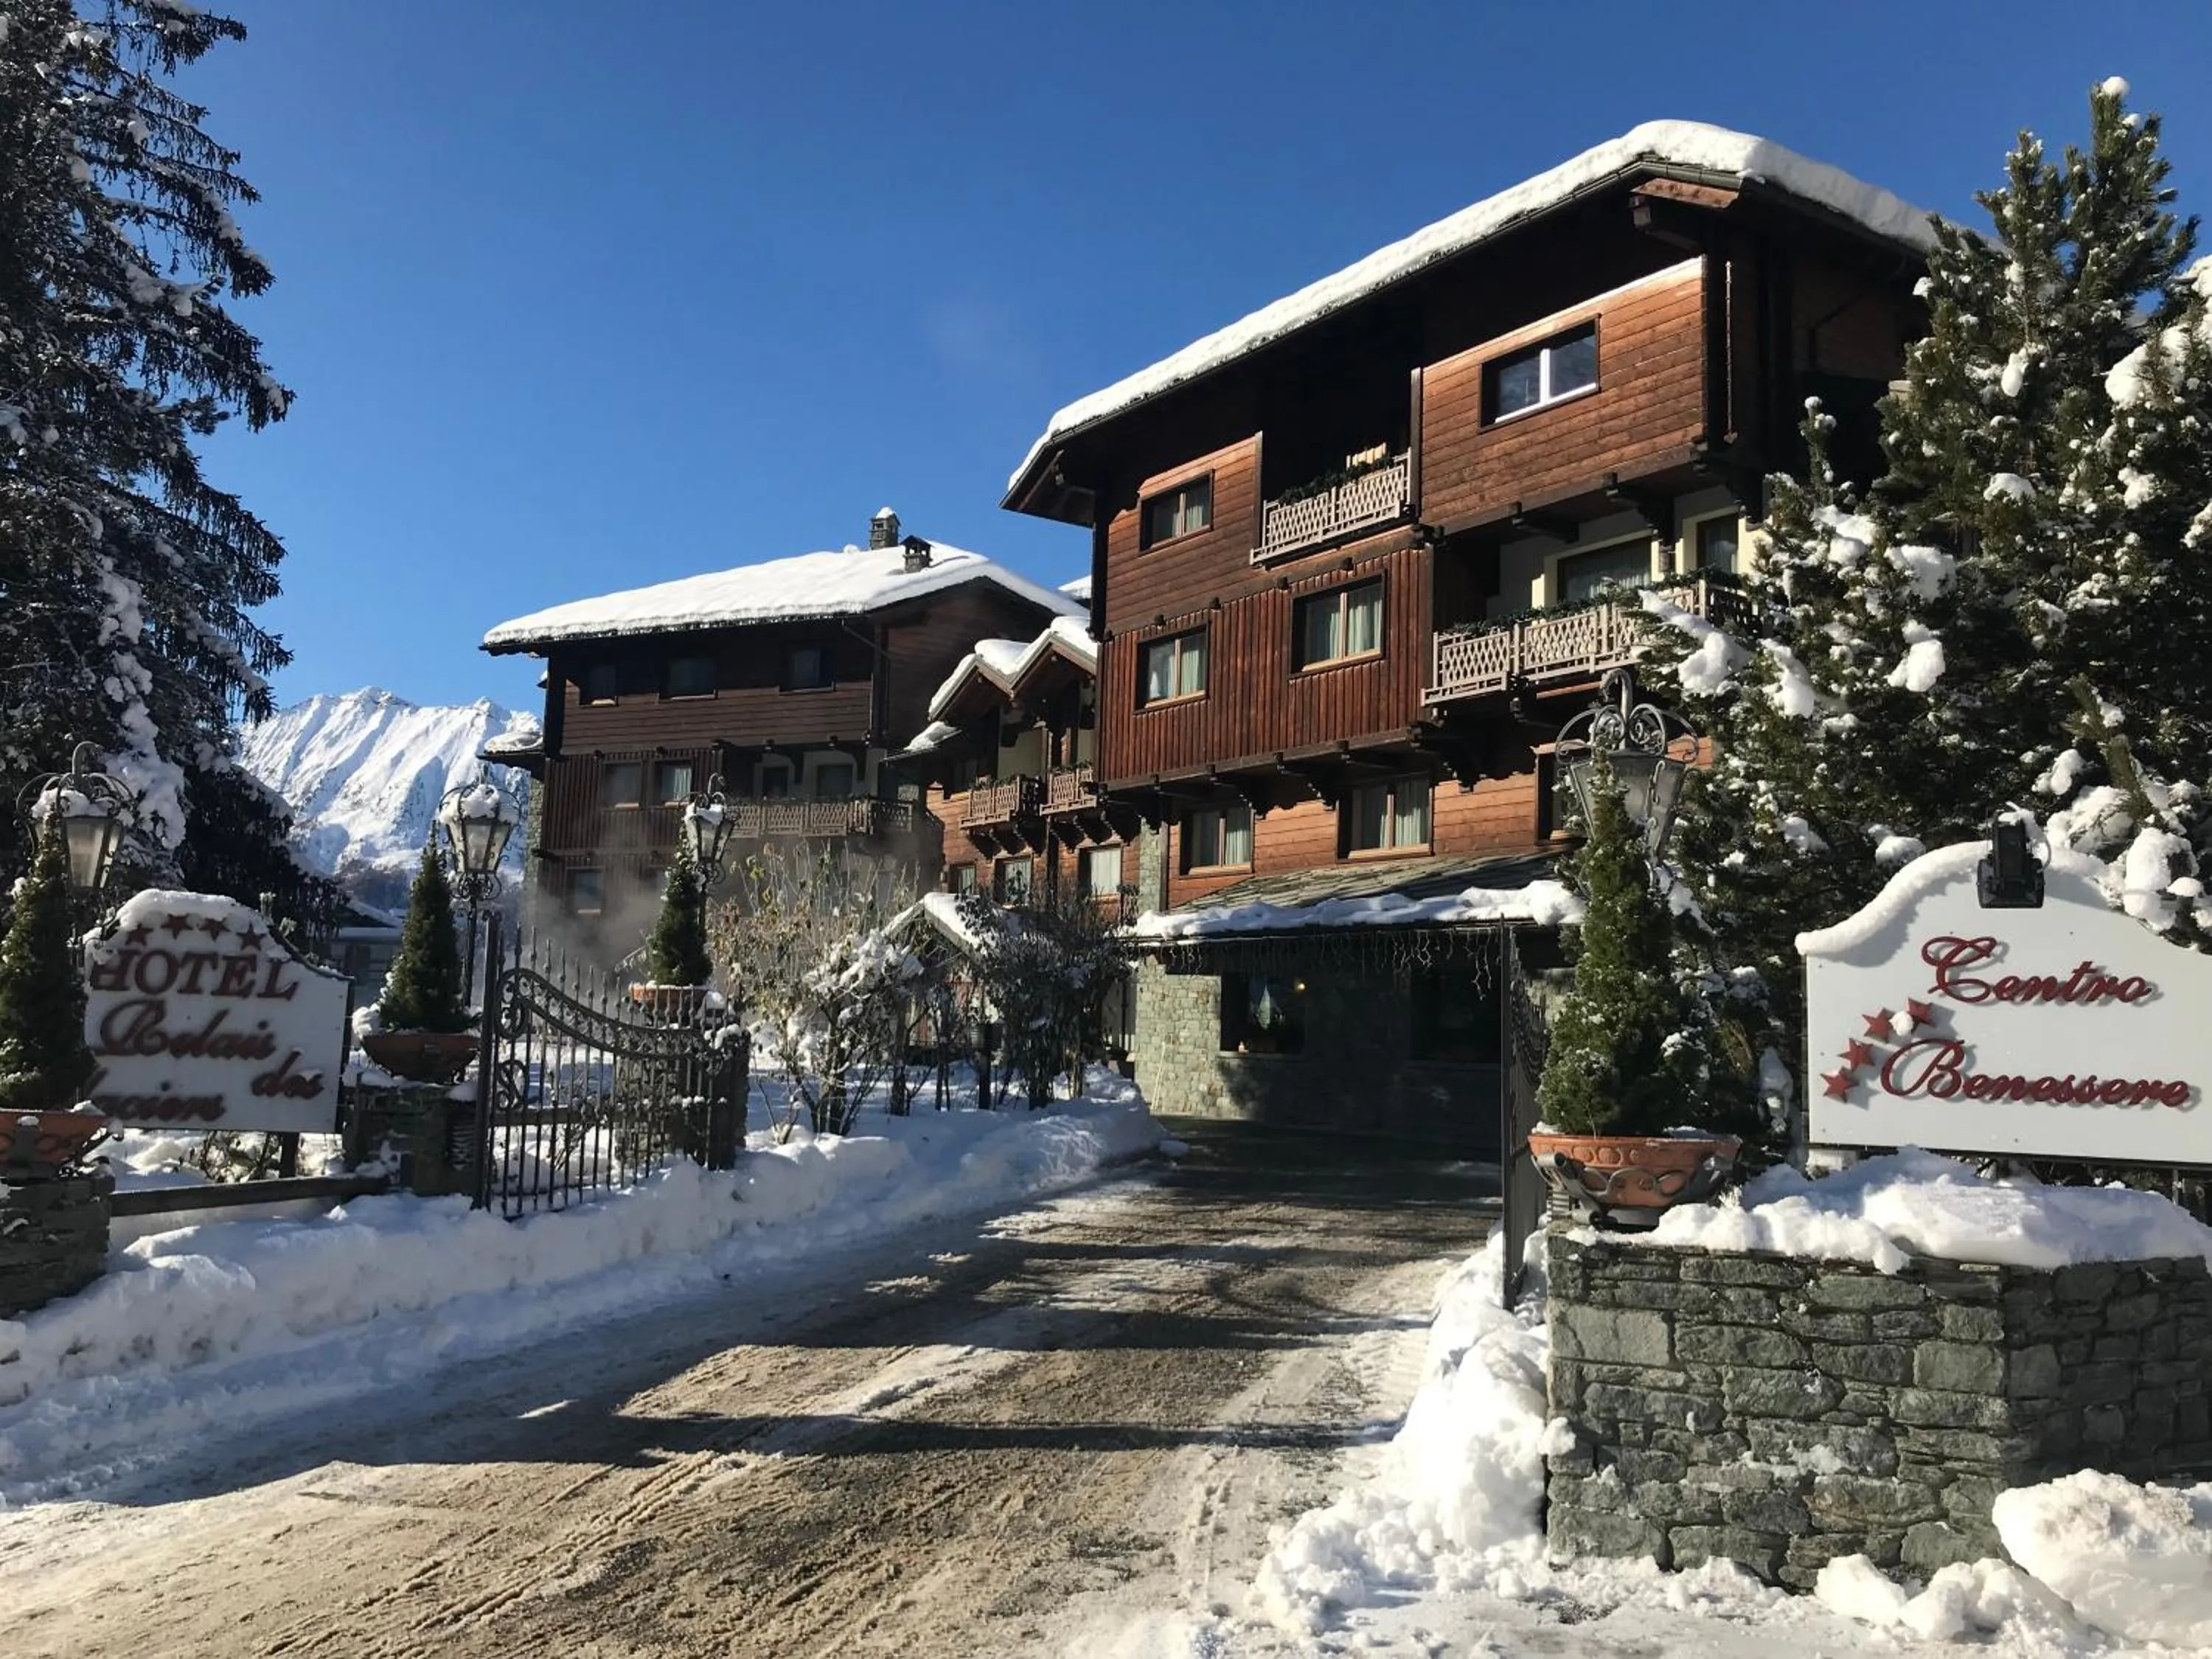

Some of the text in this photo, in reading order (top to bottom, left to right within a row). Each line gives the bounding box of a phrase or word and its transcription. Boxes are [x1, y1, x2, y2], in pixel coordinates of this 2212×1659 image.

[89, 948, 299, 1001] HOTEL
[1921, 936, 2153, 1004] Centro
[1880, 1038, 2191, 1107] Benessere
